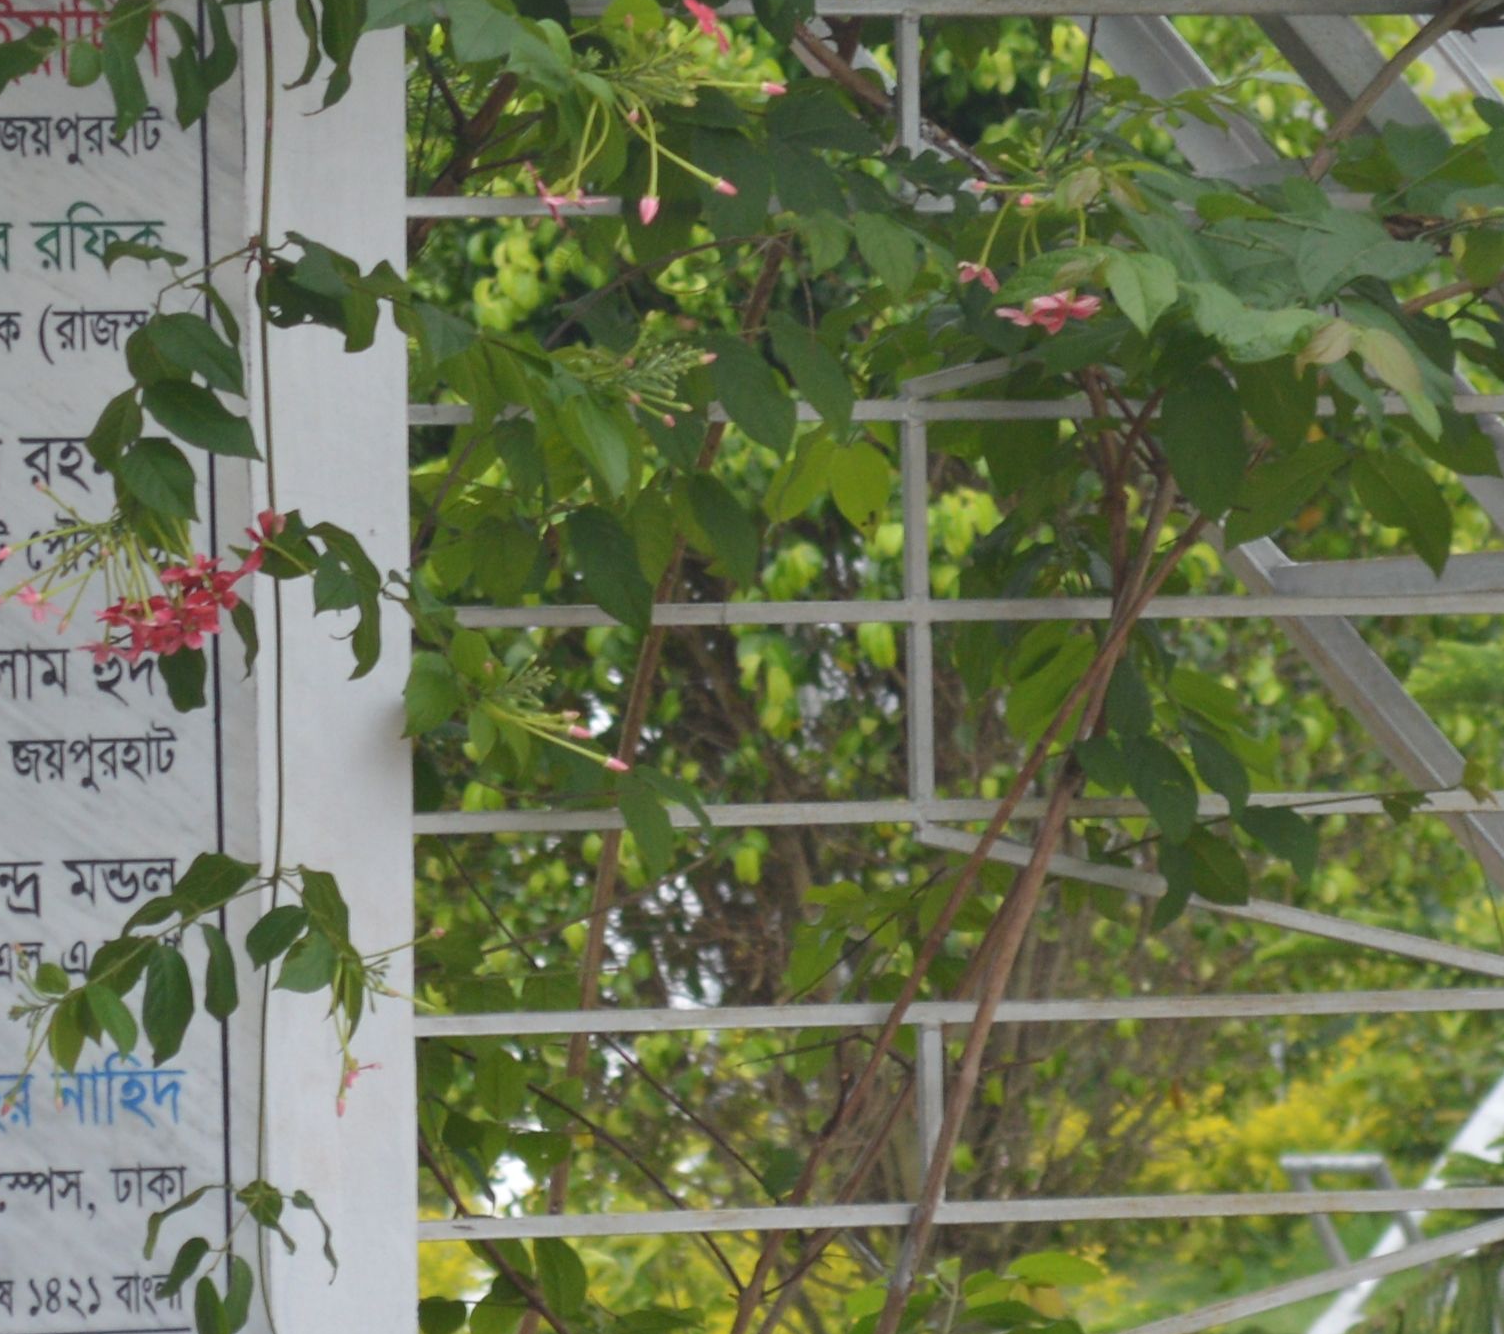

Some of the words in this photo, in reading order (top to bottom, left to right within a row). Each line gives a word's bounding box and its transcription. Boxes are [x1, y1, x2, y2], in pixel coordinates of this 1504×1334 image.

[8, 723, 177, 792] জয়পুরহাট
[48, 1051, 188, 1129] নাহিদ
[108, 1161, 190, 1209] ঢাকা
[29, 1277, 101, 1317] ১৪২১
